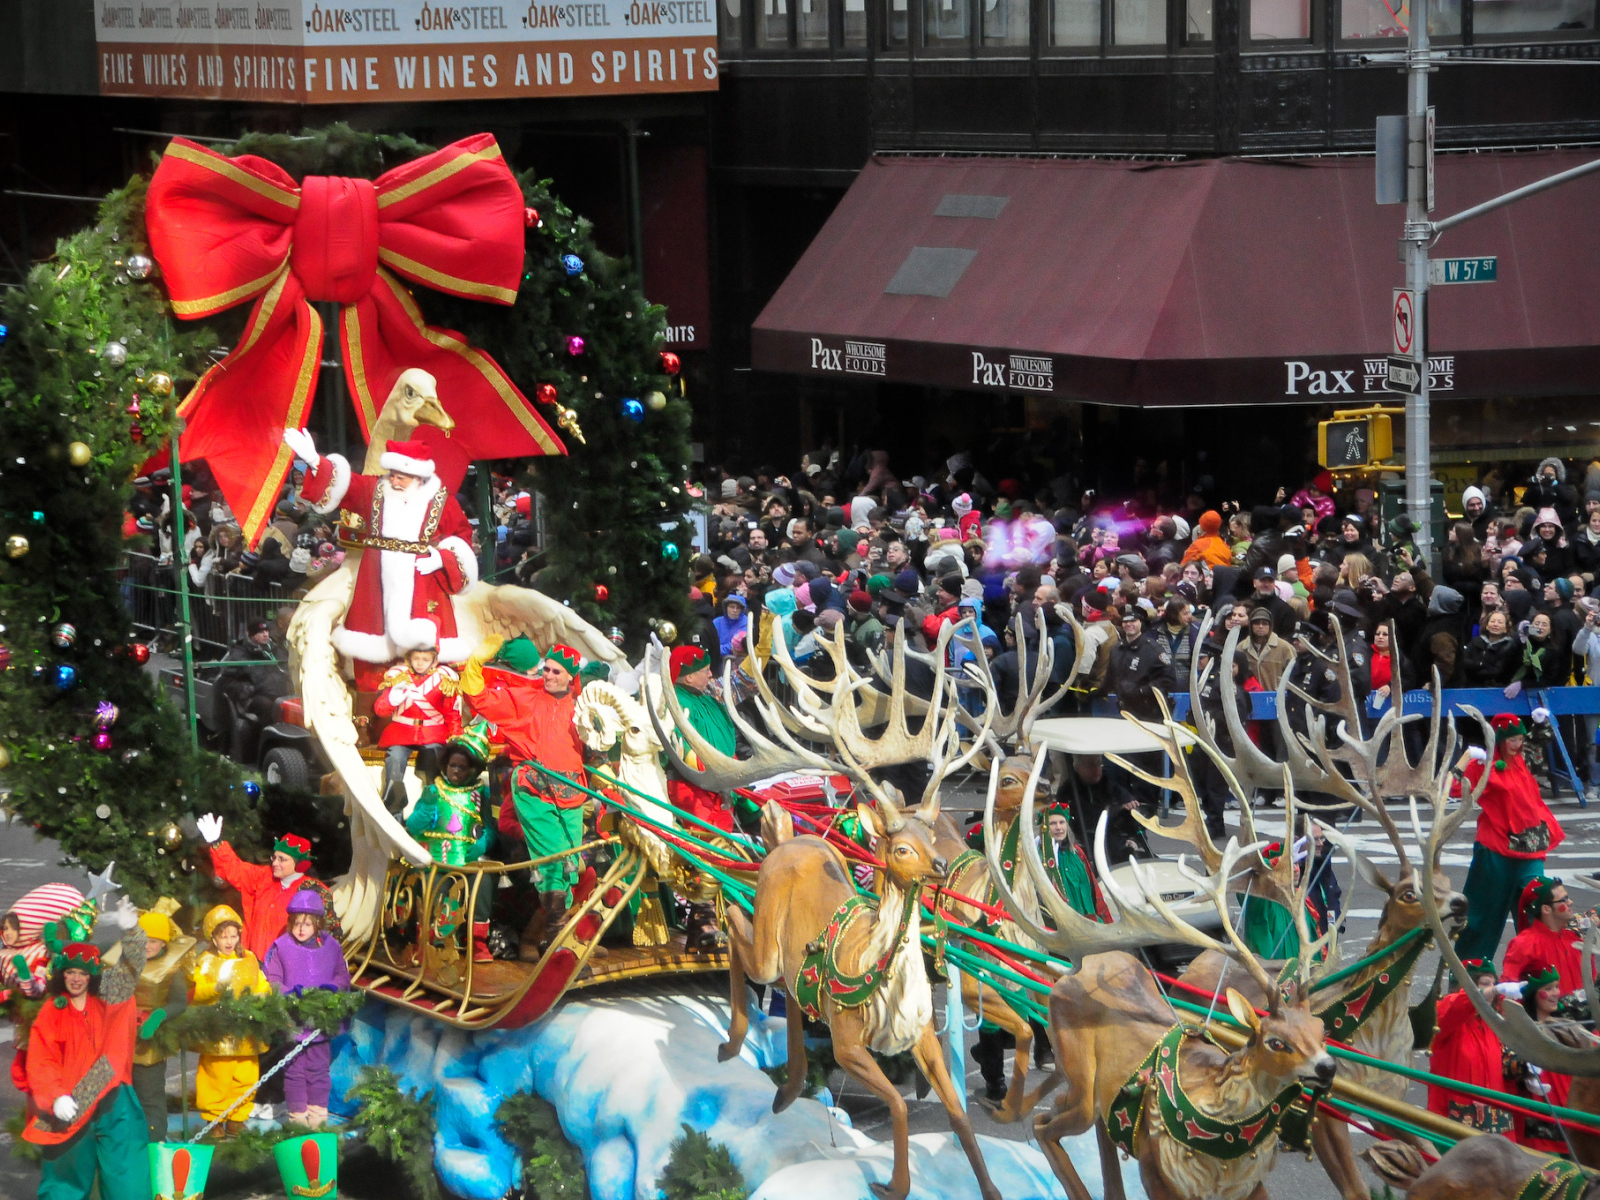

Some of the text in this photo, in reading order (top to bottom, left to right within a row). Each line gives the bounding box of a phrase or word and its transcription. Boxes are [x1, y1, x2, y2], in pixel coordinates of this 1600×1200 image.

[103, 53, 296, 90] FINE WINES AND SPIRITS
[304, 47, 717, 92] FINE WINES AND SPIRITS
[1448, 260, 1493, 280] W 57 ST
[665, 325, 695, 342] RITS
[811, 338, 842, 371] Pax
[845, 343, 886, 358] WHOLESOME
[845, 360, 886, 373] FOODS
[972, 351, 1006, 386] Pax
[1009, 357, 1053, 373] WHOLESOME
[1009, 373, 1053, 389] FOODS
[1284, 361, 1355, 395] Pax
